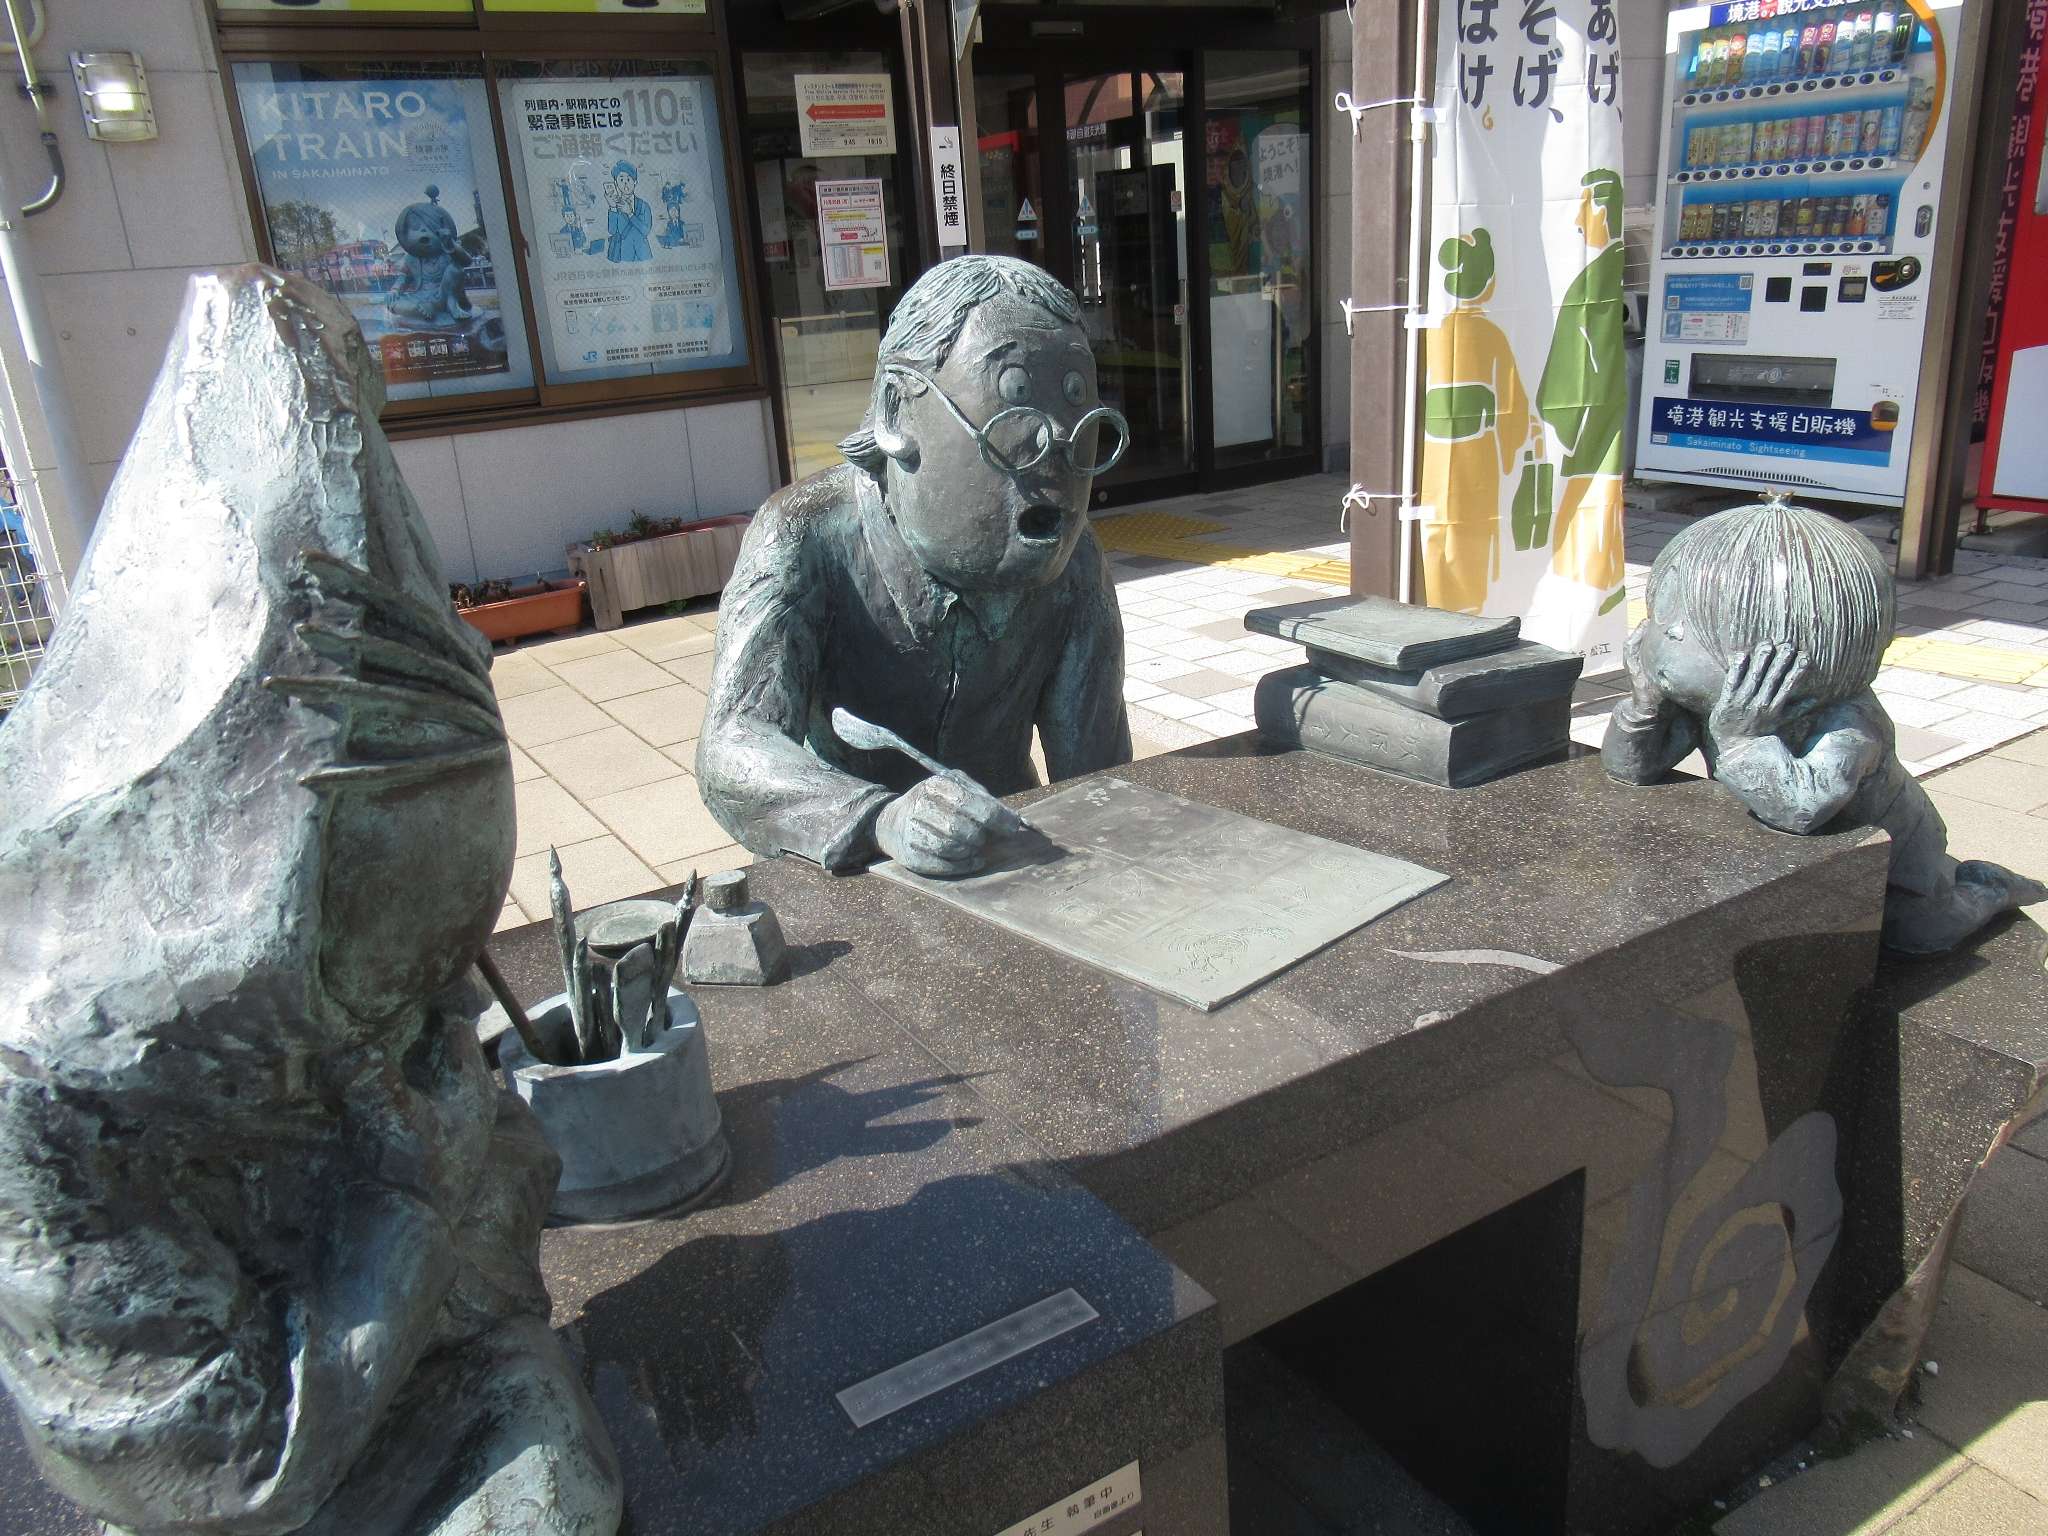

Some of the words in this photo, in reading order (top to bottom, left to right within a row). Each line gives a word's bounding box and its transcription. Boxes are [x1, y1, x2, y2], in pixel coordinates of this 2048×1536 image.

[256, 91, 426, 121] KITARO
[622, 88, 680, 127] 110
[527, 112, 624, 131] 緊急事態には
[264, 130, 409, 161] TRAIN
[532, 130, 698, 160] ご通報ください
[272, 170, 288, 179] IN
[293, 166, 390, 178] SAKAIMINATO
[940, 164, 960, 227] 終日禁煙
[1666, 404, 1857, 436] 境港観光支援自販機
[1686, 436, 1742, 451] Sakaiminato
[1749, 439, 1806, 459] Sightseeing
